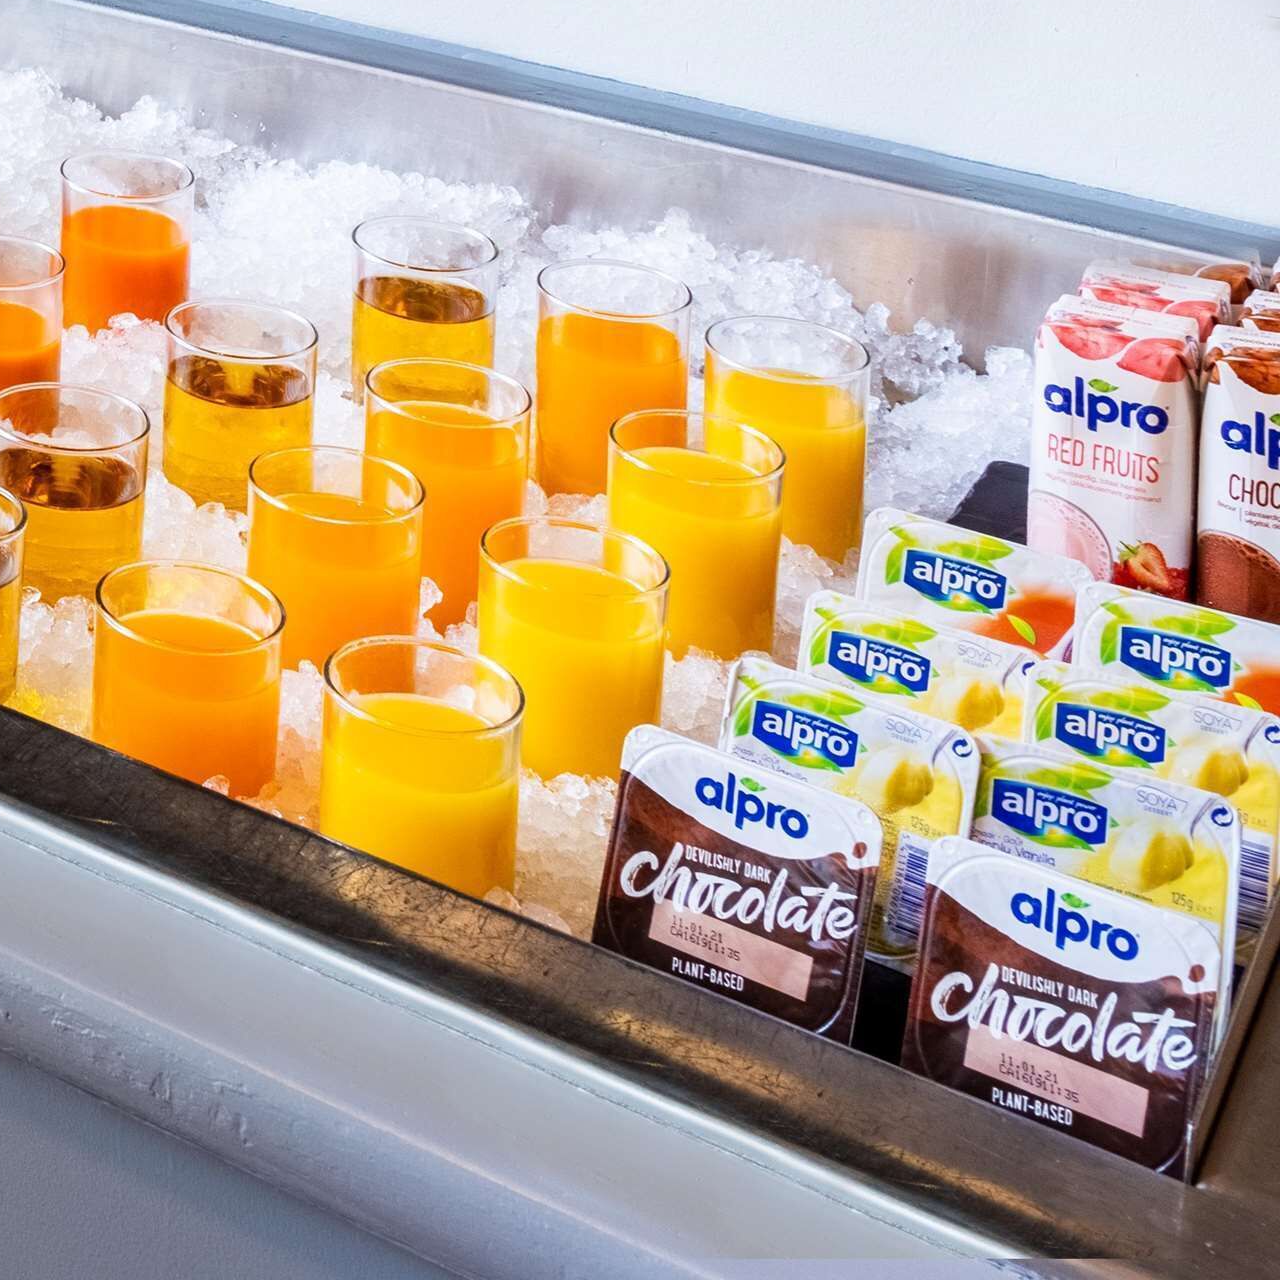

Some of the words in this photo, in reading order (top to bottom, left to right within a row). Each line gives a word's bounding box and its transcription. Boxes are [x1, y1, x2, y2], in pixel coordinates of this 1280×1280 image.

[1044, 376, 1169, 435] alpro
[1047, 433, 1085, 467] RED
[912, 557, 999, 599] alpro
[837, 639, 922, 682] alpro
[1129, 634, 1223, 676] alpro
[762, 710, 850, 757] alpro
[886, 718, 924, 740] SOYA
[1064, 709, 1158, 753] alpro
[1192, 710, 1233, 731] SOYA
[694, 772, 810, 840] alpro
[1001, 787, 1100, 834] alpro
[1137, 788, 1178, 812] SOYA
[684, 844, 741, 875] DEVILISHLY
[743, 862, 772, 885] DARK
[619, 841, 859, 942] chocolate
[1010, 887, 1140, 962] alpro
[671, 956, 745, 993] PLANT-BASED
[1000, 965, 1065, 999] DEVILISHLY
[1066, 985, 1099, 1010] DARK
[930, 961, 1198, 1073] chocolate
[991, 1085, 1074, 1127] PLANT-BASED
